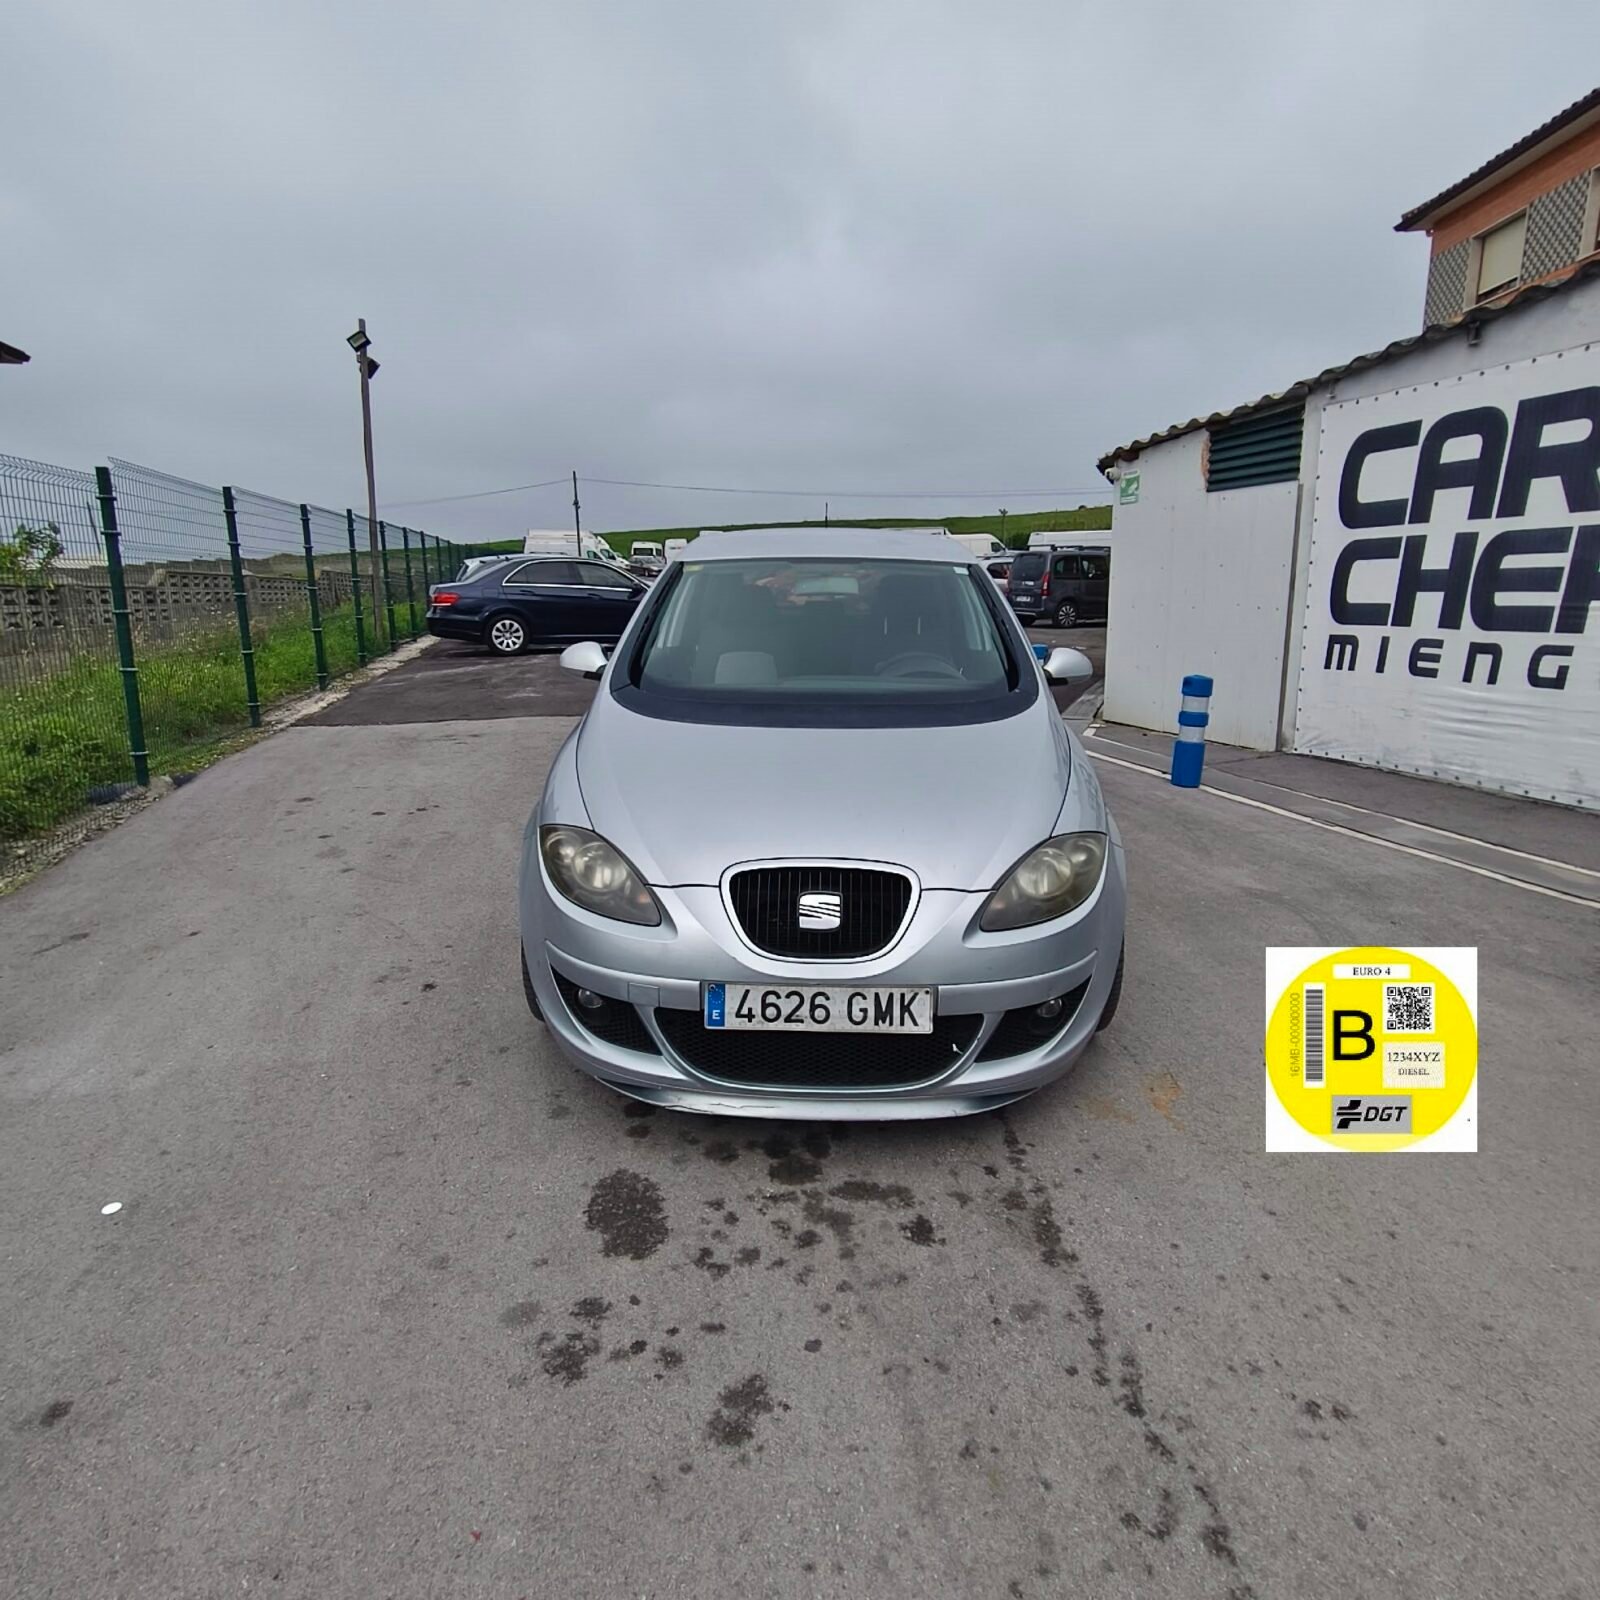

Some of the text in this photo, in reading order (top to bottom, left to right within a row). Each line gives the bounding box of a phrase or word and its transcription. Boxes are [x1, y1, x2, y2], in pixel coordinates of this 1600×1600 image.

[712, 989, 920, 1027] E 4626 GMK
